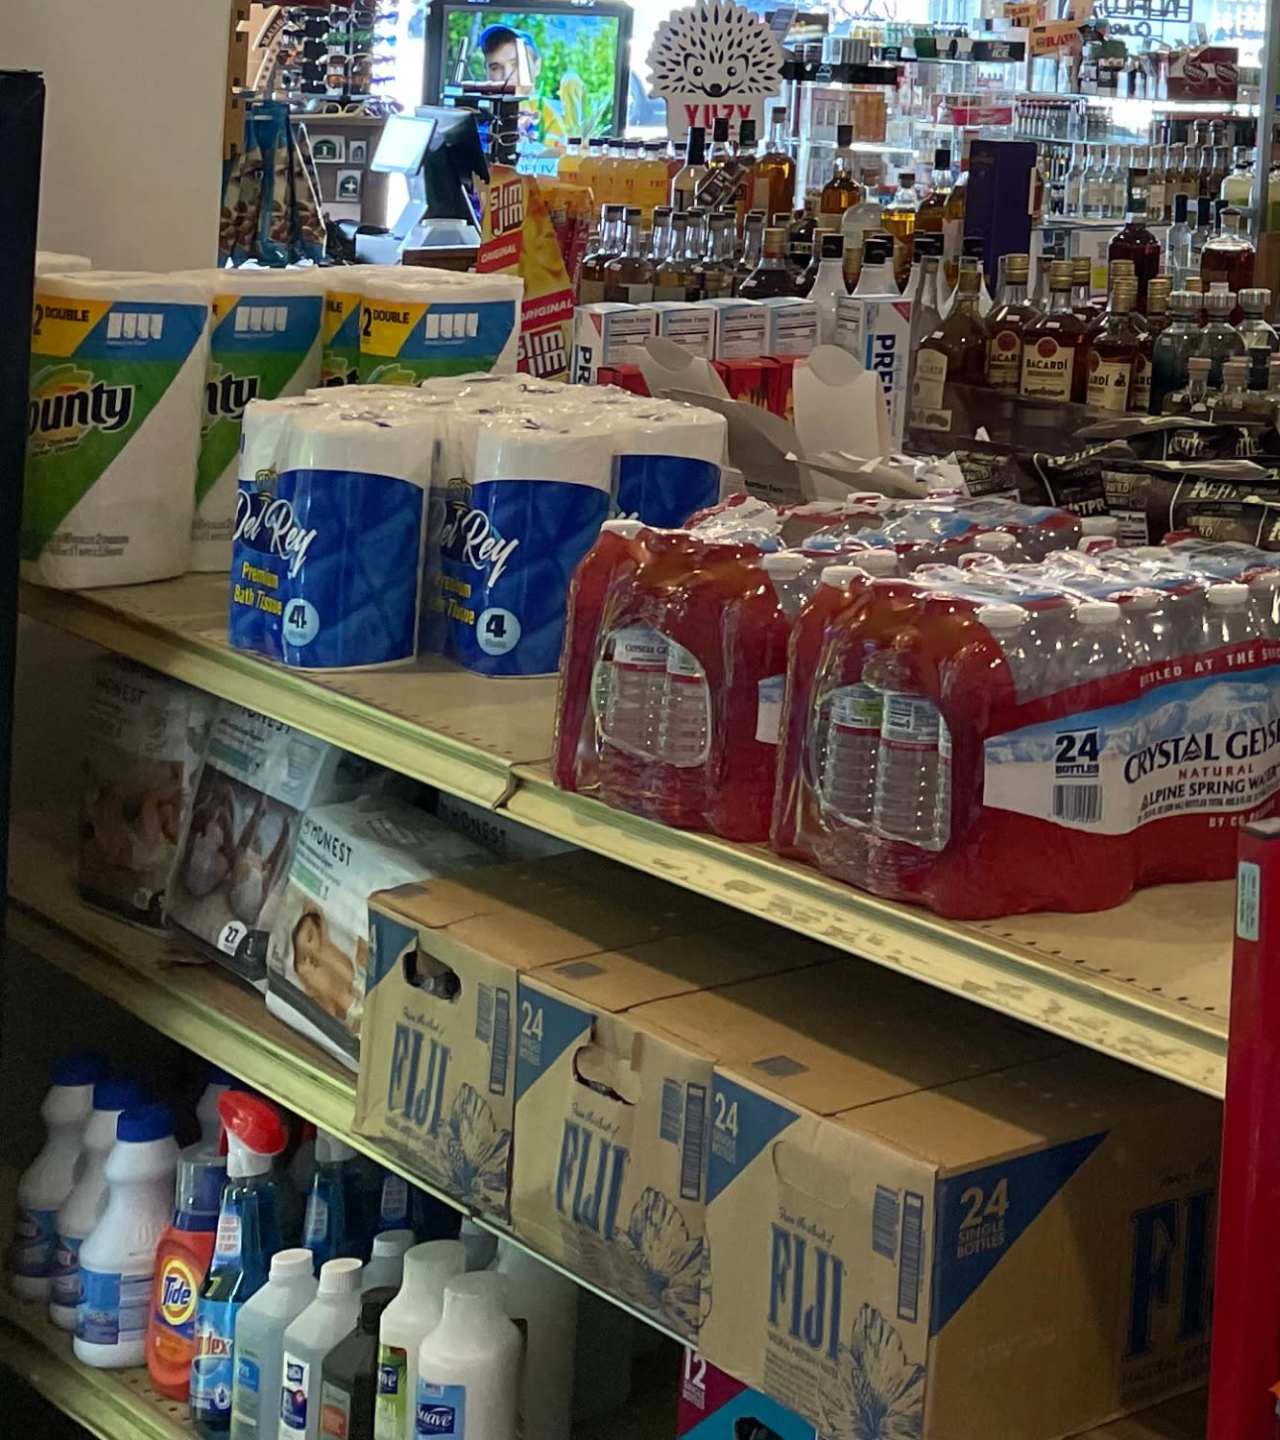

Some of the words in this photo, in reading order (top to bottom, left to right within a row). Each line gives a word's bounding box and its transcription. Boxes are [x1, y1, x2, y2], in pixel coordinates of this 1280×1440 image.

[480, 244, 517, 264] ORIGINAL
[45, 307, 89, 323] DOUBLE
[373, 310, 410, 325] DOUBLE
[1026, 356, 1068, 372] BACARDÍ
[1088, 374, 1109, 387] ARDÍ
[30, 380, 134, 433] ounty
[205, 375, 258, 421] nty
[232, 489, 268, 542] Del
[265, 498, 317, 578] Rey
[462, 510, 519, 588] Rey
[242, 561, 279, 589] Premium
[254, 592, 282, 616] Tissue
[288, 605, 307, 629] 4
[486, 614, 507, 638] 4
[1195, 660, 1213, 673] AT
[1227, 651, 1255, 666] THE
[1055, 730, 1100, 763] 24
[1124, 732, 1220, 785] CRYSTAL
[1055, 763, 1100, 775] BOTTLES
[1178, 763, 1255, 780] NATURAL
[1141, 784, 1185, 811] ALPINE
[1189, 776, 1246, 797] SPRING
[311, 823, 354, 868] HONEST
[224, 923, 238, 945] 27
[522, 1002, 544, 1041] 24
[387, 1022, 451, 1138] FIJI
[715, 1092, 738, 1136] 24
[556, 1119, 629, 1242] FIJI
[959, 1177, 1009, 1229] 24
[957, 1234, 1006, 1259] BOTTLES
[161, 1274, 192, 1307] Tide
[1124, 1188, 1214, 1360] FI
[768, 1222, 844, 1361] FIJI
[683, 1347, 706, 1391] 12
